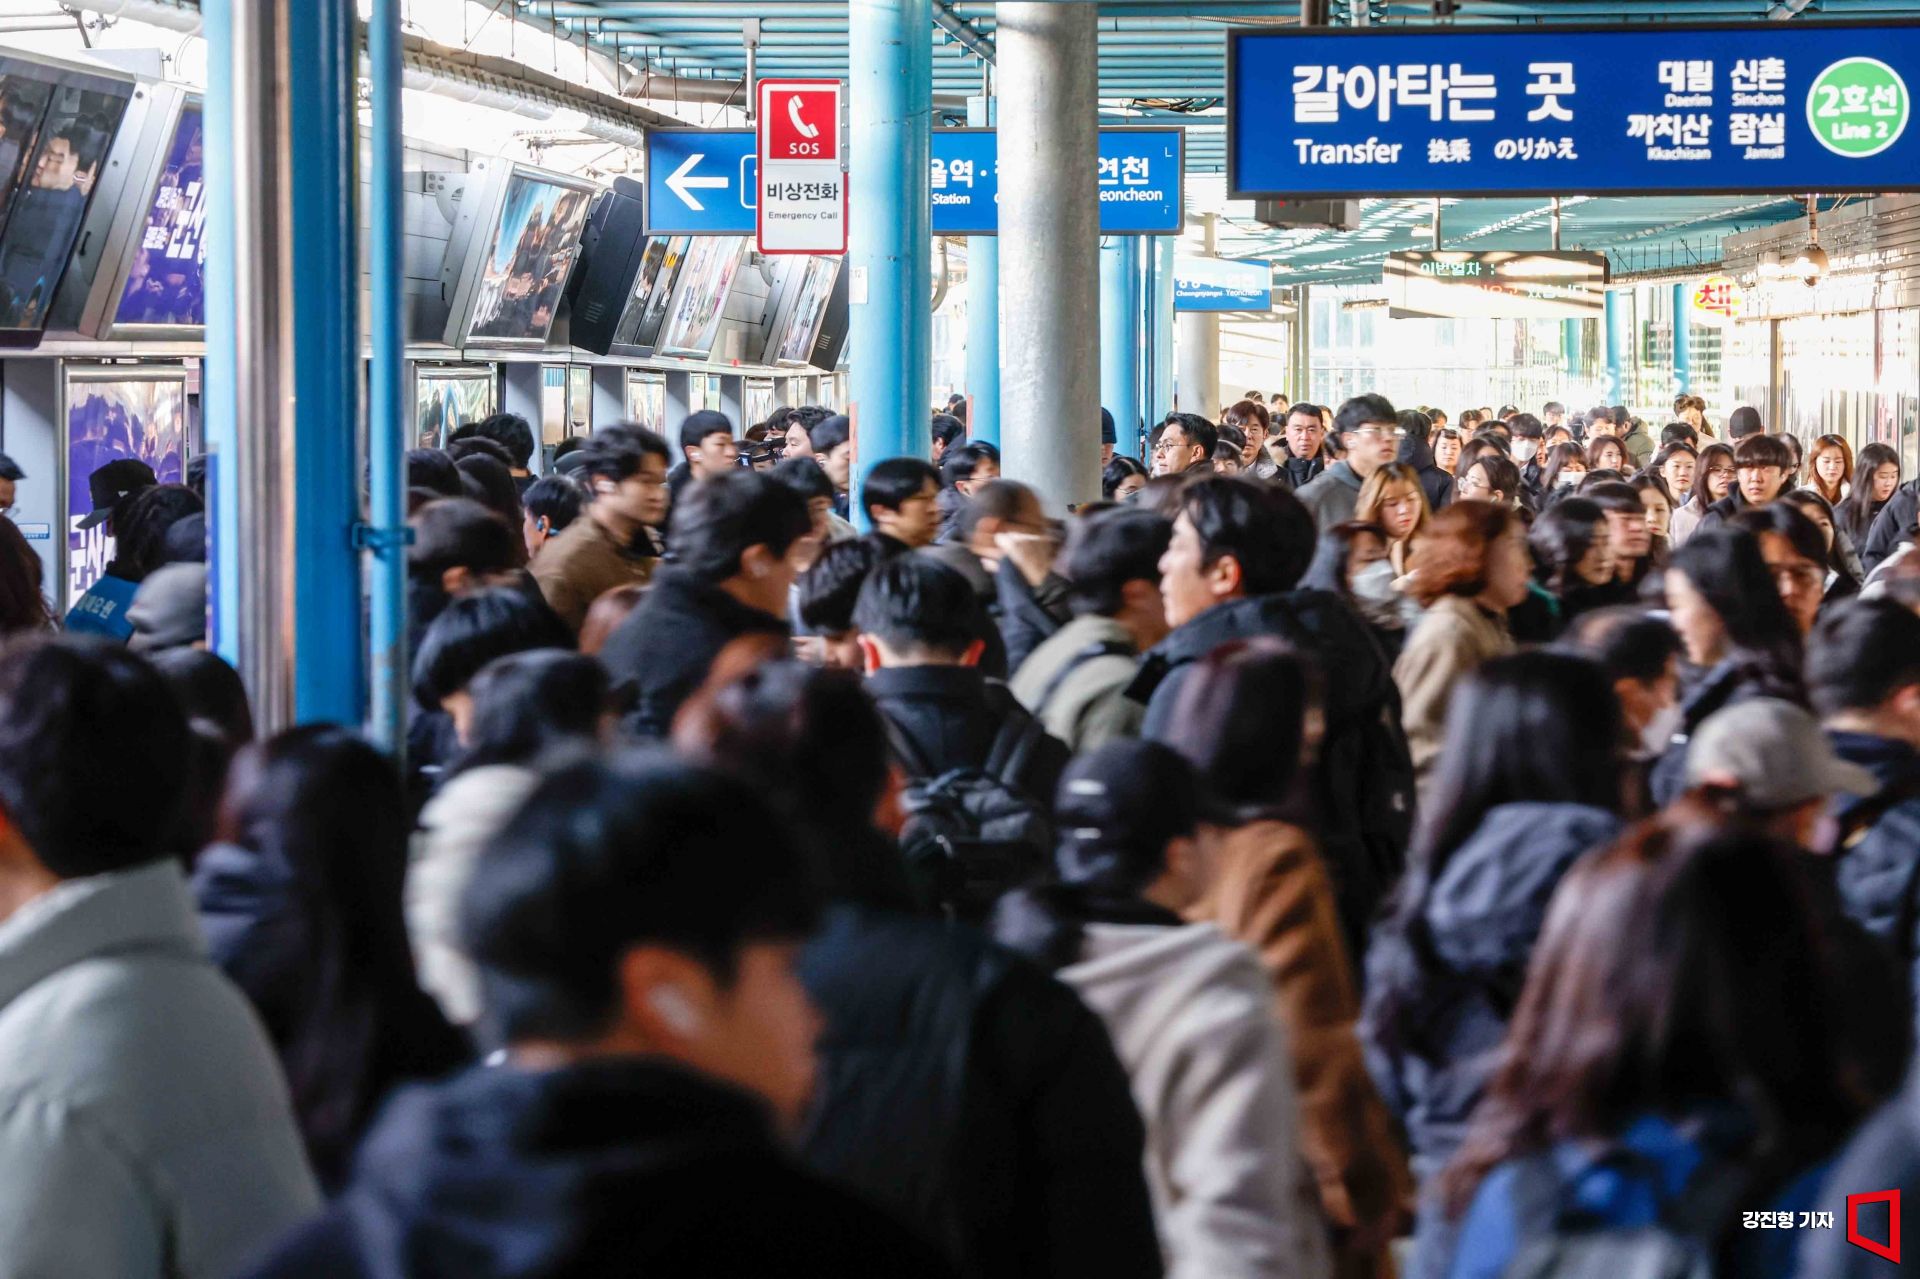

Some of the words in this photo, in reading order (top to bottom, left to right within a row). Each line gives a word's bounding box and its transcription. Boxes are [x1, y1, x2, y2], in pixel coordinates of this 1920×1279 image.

[1658, 60, 1714, 92] 대림
[1730, 57, 1786, 91] 신촌
[1293, 64, 1497, 123] 갈아타는
[1525, 62, 1576, 122] 곳
[1664, 94, 1713, 107] Daerim
[1731, 93, 1785, 106] Sinchon
[1817, 84, 1898, 117] 2호선
[1626, 114, 1713, 146] 까치산
[1730, 113, 1786, 145] 잠실
[1832, 122, 1872, 140] Line
[1874, 121, 1889, 138] 2
[789, 142, 820, 155] SOS
[1293, 137, 1402, 164] Transfer
[1494, 137, 1578, 160] のりかえ
[1098, 156, 1149, 185] 연천
[767, 182, 839, 201] 비상전화
[933, 192, 971, 205] Station
[1099, 187, 1163, 202] eoncheon
[768, 211, 817, 220] Emergency
[820, 211, 838, 219] Call
[1420, 261, 1482, 277] 이번열차
